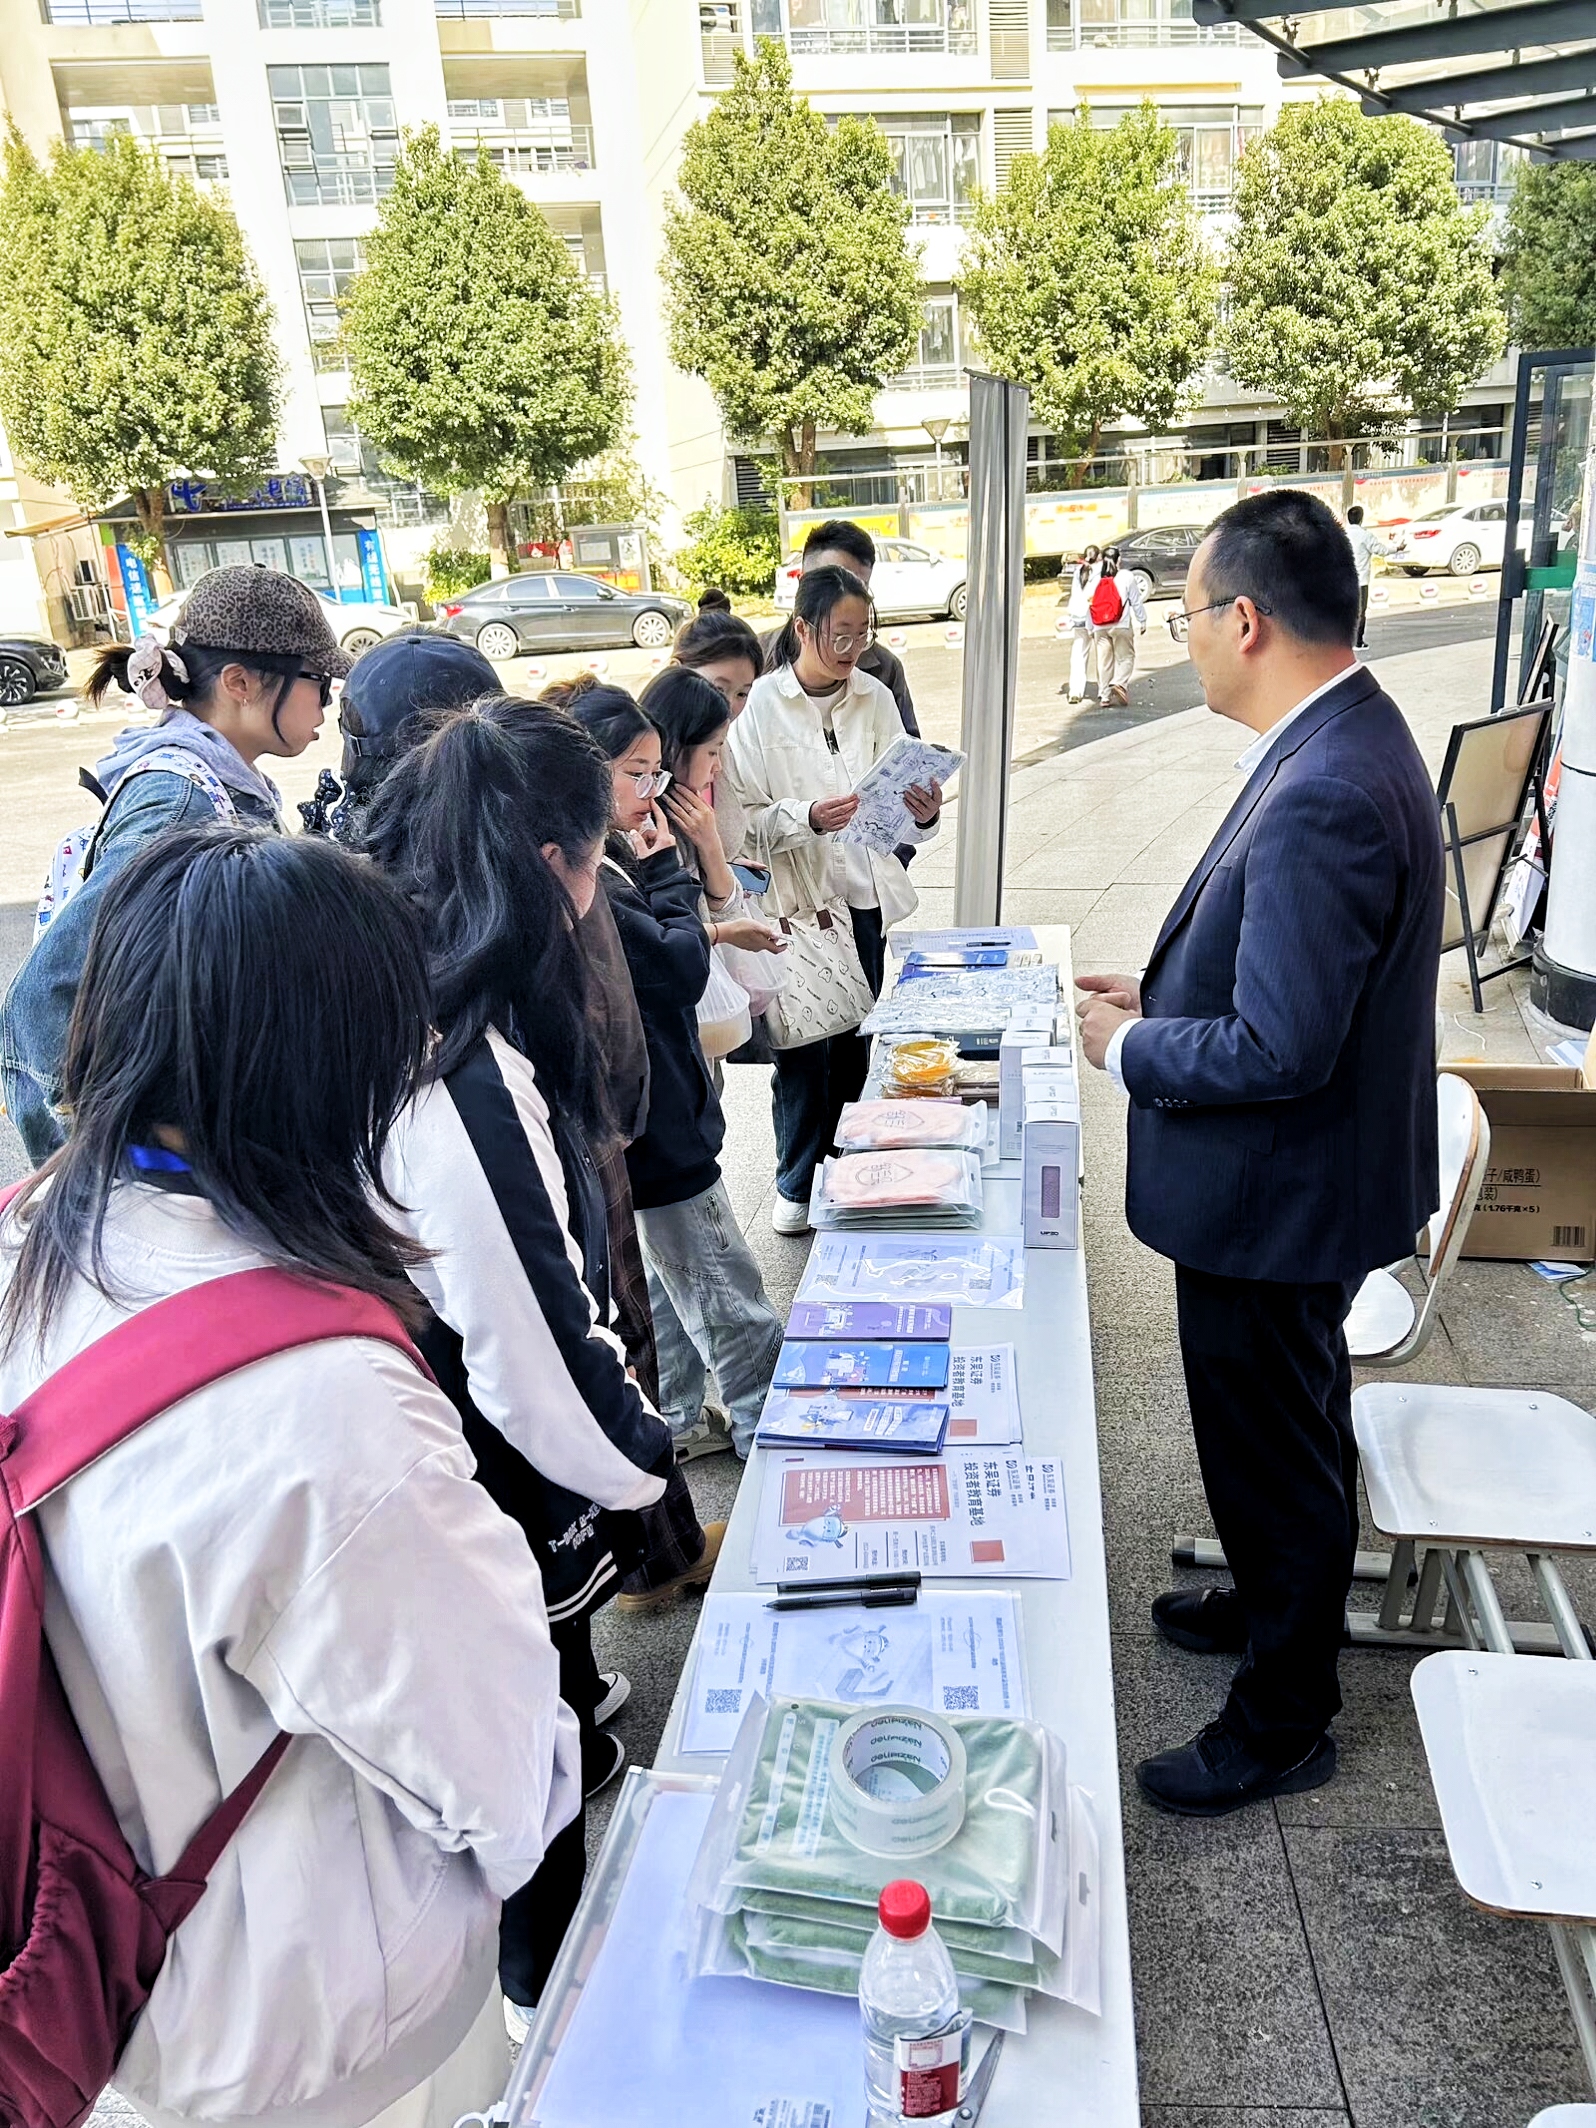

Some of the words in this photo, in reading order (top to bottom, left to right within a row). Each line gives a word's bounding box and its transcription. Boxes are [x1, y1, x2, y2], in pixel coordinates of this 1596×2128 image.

[1483, 1168, 1541, 1184] 子/咸鸭蛋)
[951, 1356, 965, 1407] 投资者教育基地
[970, 1355, 983, 1385] 东吴证券
[963, 1462, 985, 1527] 投资者教育基地
[983, 1461, 1001, 1498] 东吴证券
